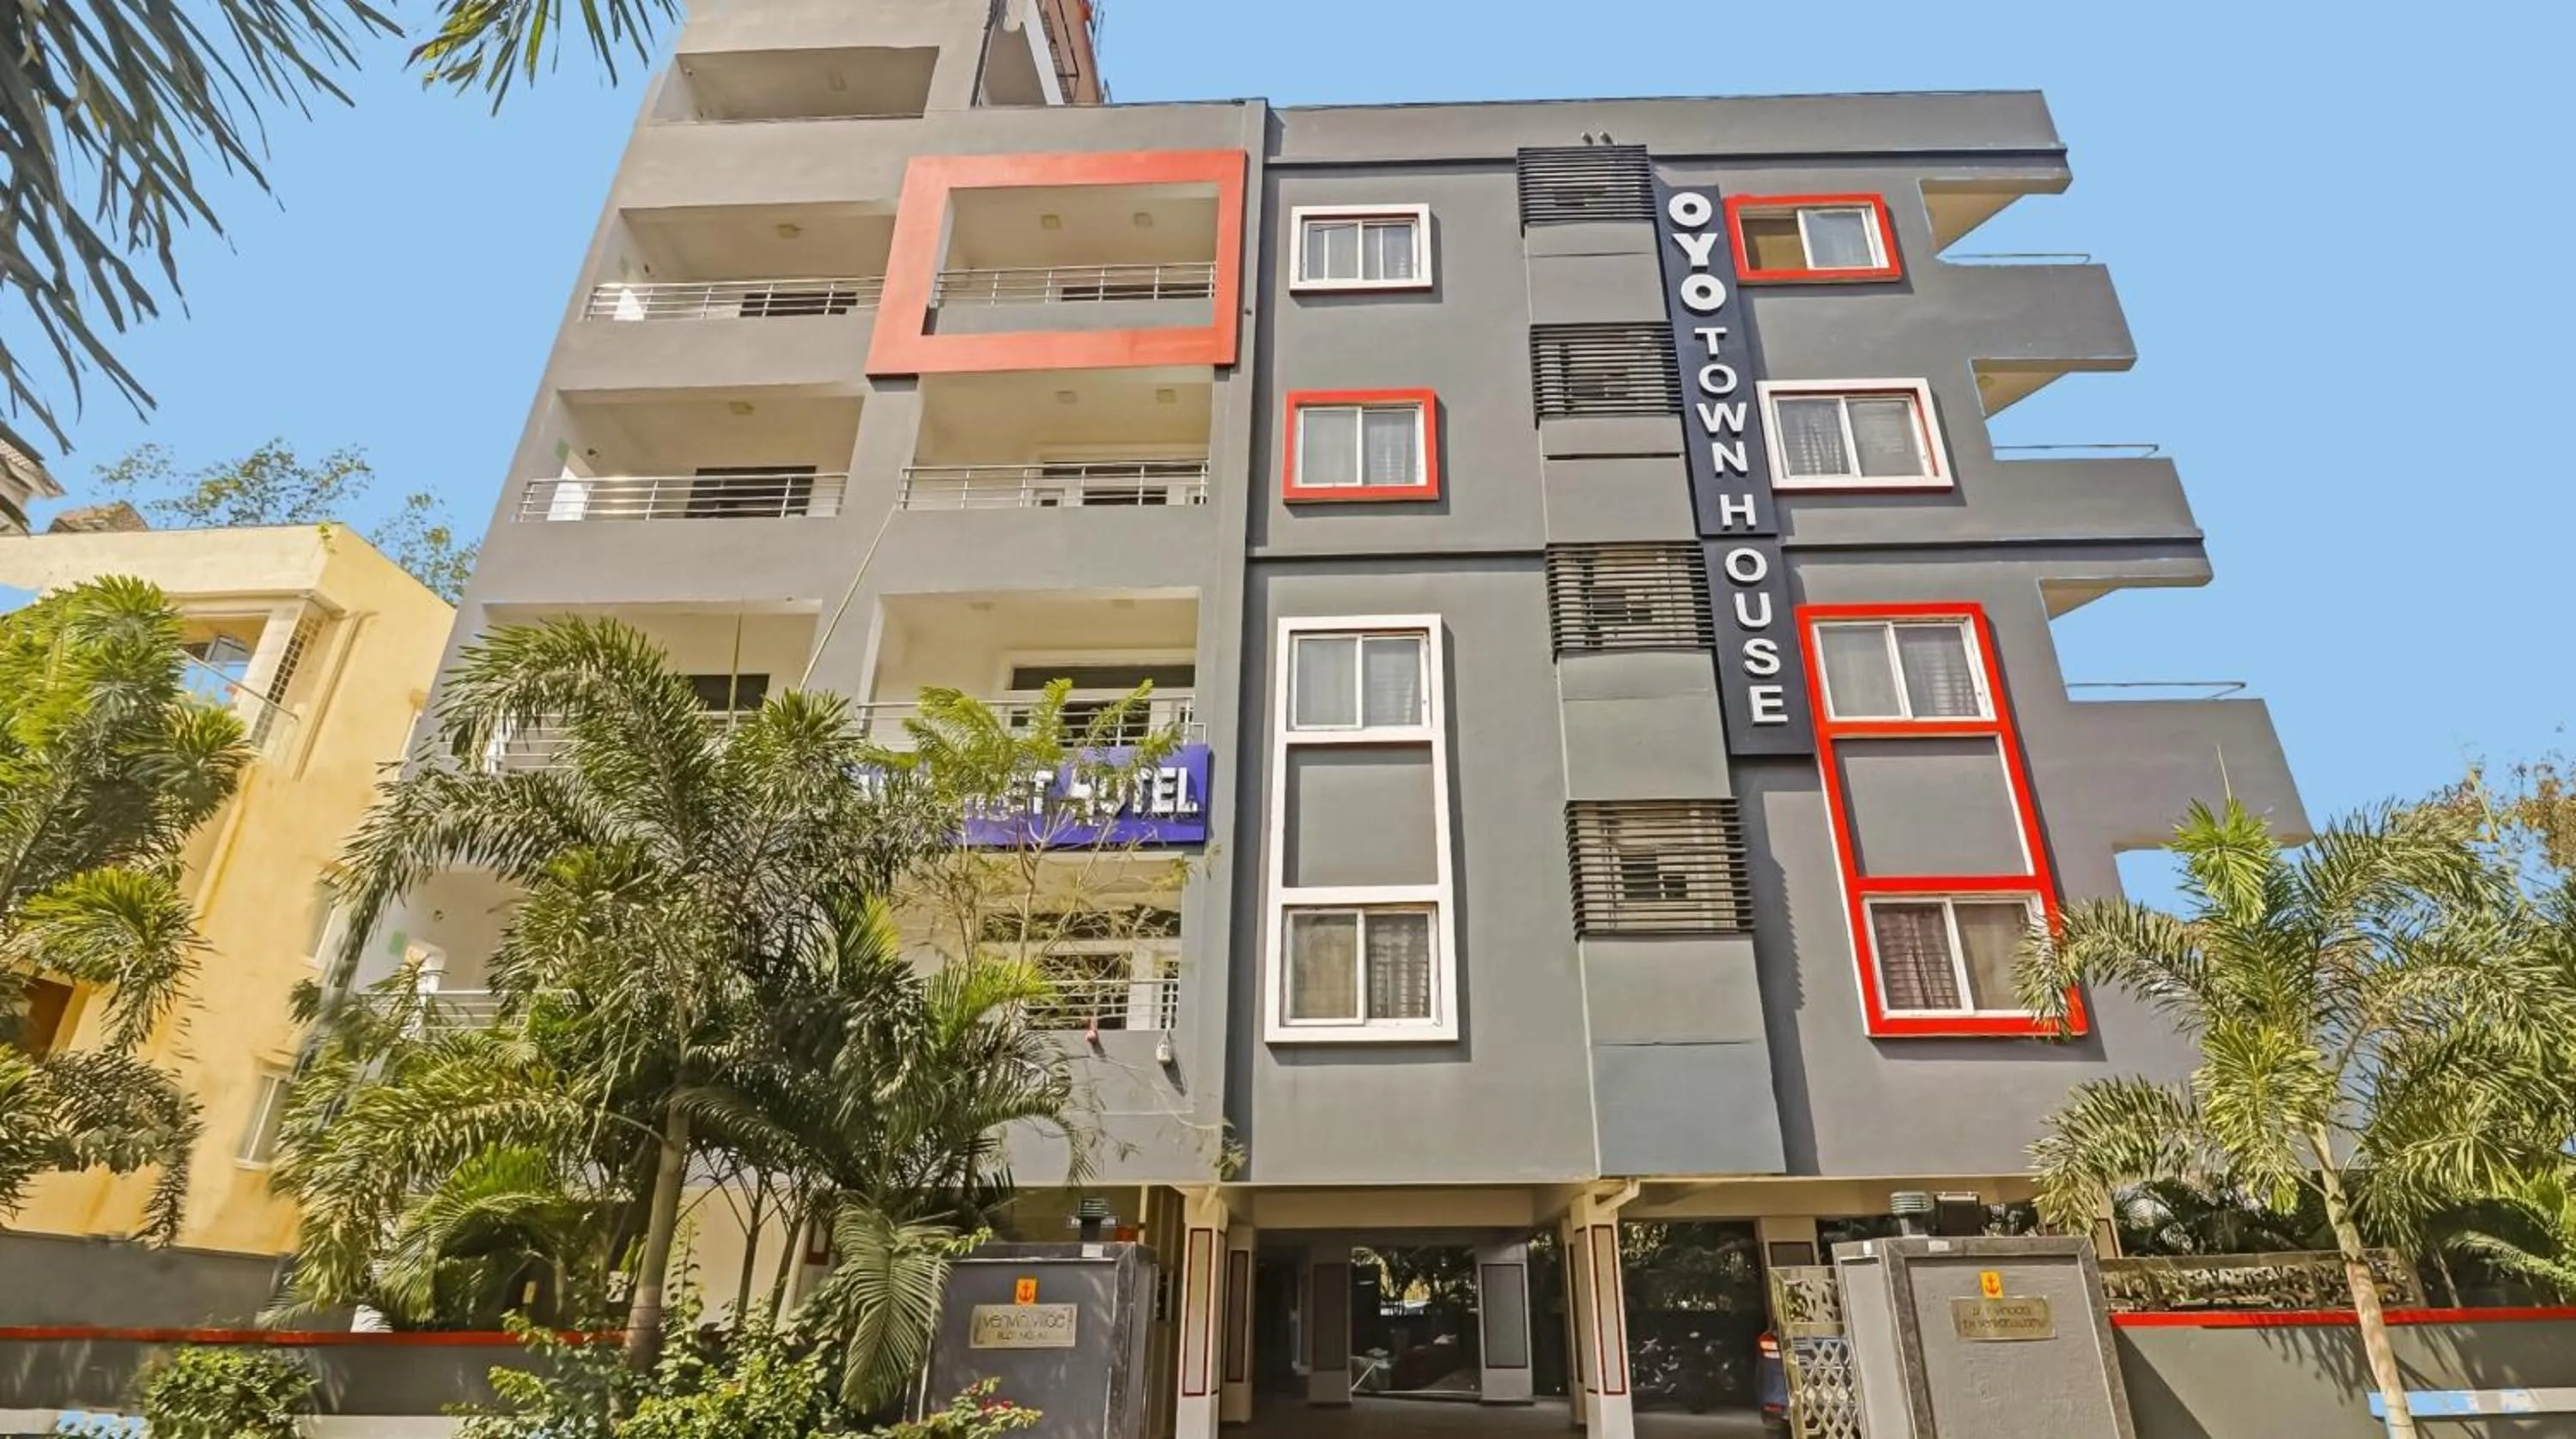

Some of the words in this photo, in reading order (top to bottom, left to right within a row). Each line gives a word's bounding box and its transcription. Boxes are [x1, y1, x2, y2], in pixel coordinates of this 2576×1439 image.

[1668, 191, 1726, 312] OYO
[1694, 327, 1749, 473] TOWN
[1719, 494, 1789, 724] HOUSE
